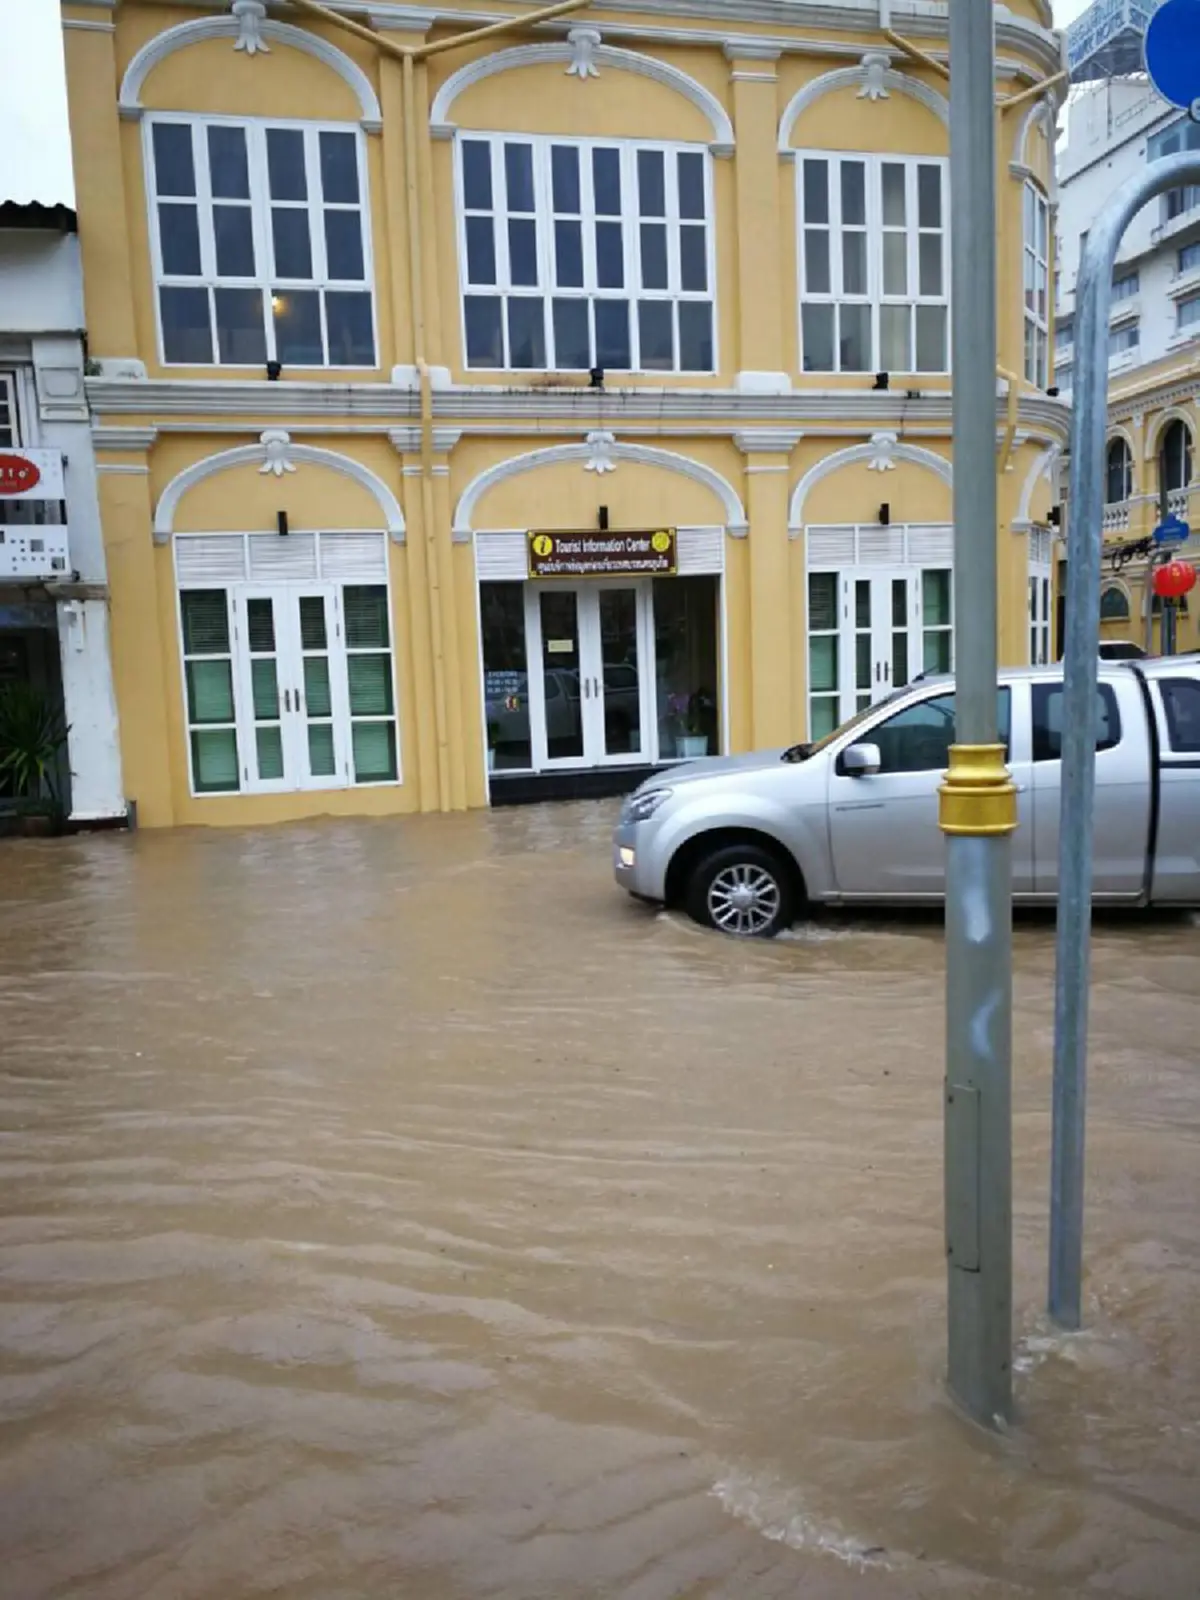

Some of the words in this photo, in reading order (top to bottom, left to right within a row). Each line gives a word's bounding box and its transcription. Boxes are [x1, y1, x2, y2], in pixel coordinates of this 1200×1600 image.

[556, 539, 582, 553] Tourist
[583, 538, 626, 553] Information
[626, 537, 650, 552] Center
